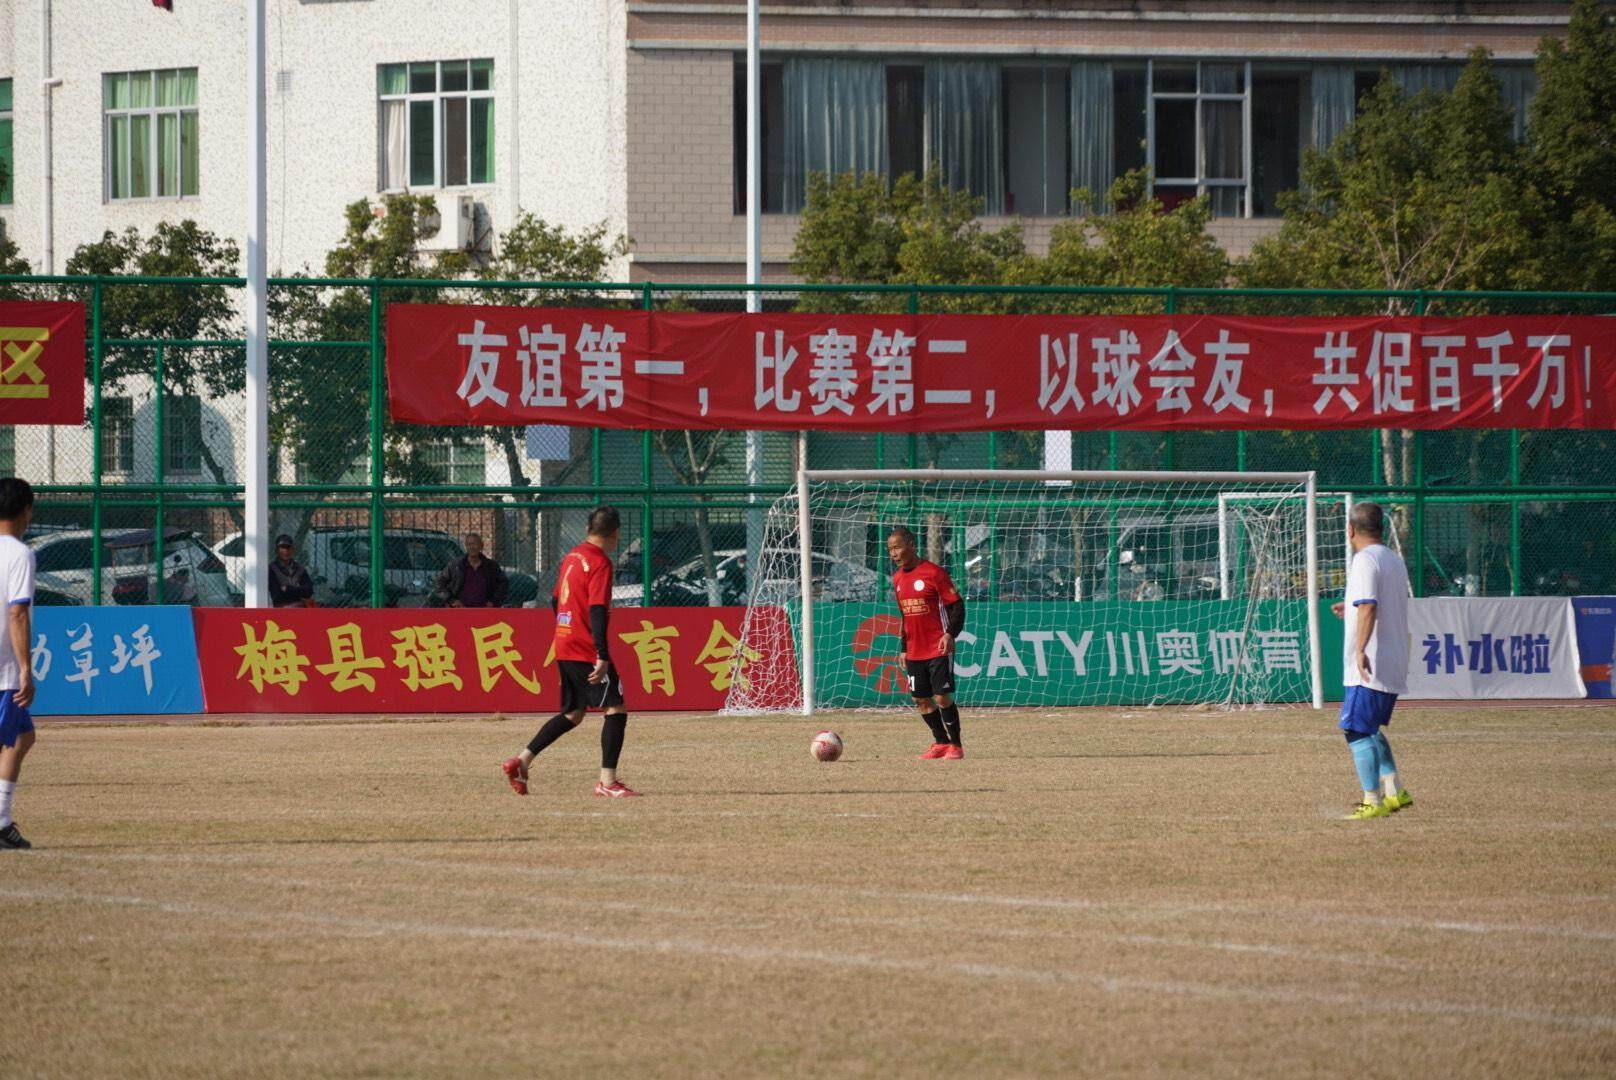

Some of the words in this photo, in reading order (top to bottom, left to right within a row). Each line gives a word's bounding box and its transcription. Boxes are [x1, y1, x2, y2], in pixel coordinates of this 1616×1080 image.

[235, 620, 763, 697] 梅县强民育会
[953, 630, 1094, 678] CATY
[1107, 629, 1302, 678] 川奥体育
[1423, 633, 1551, 675] 补水啦
